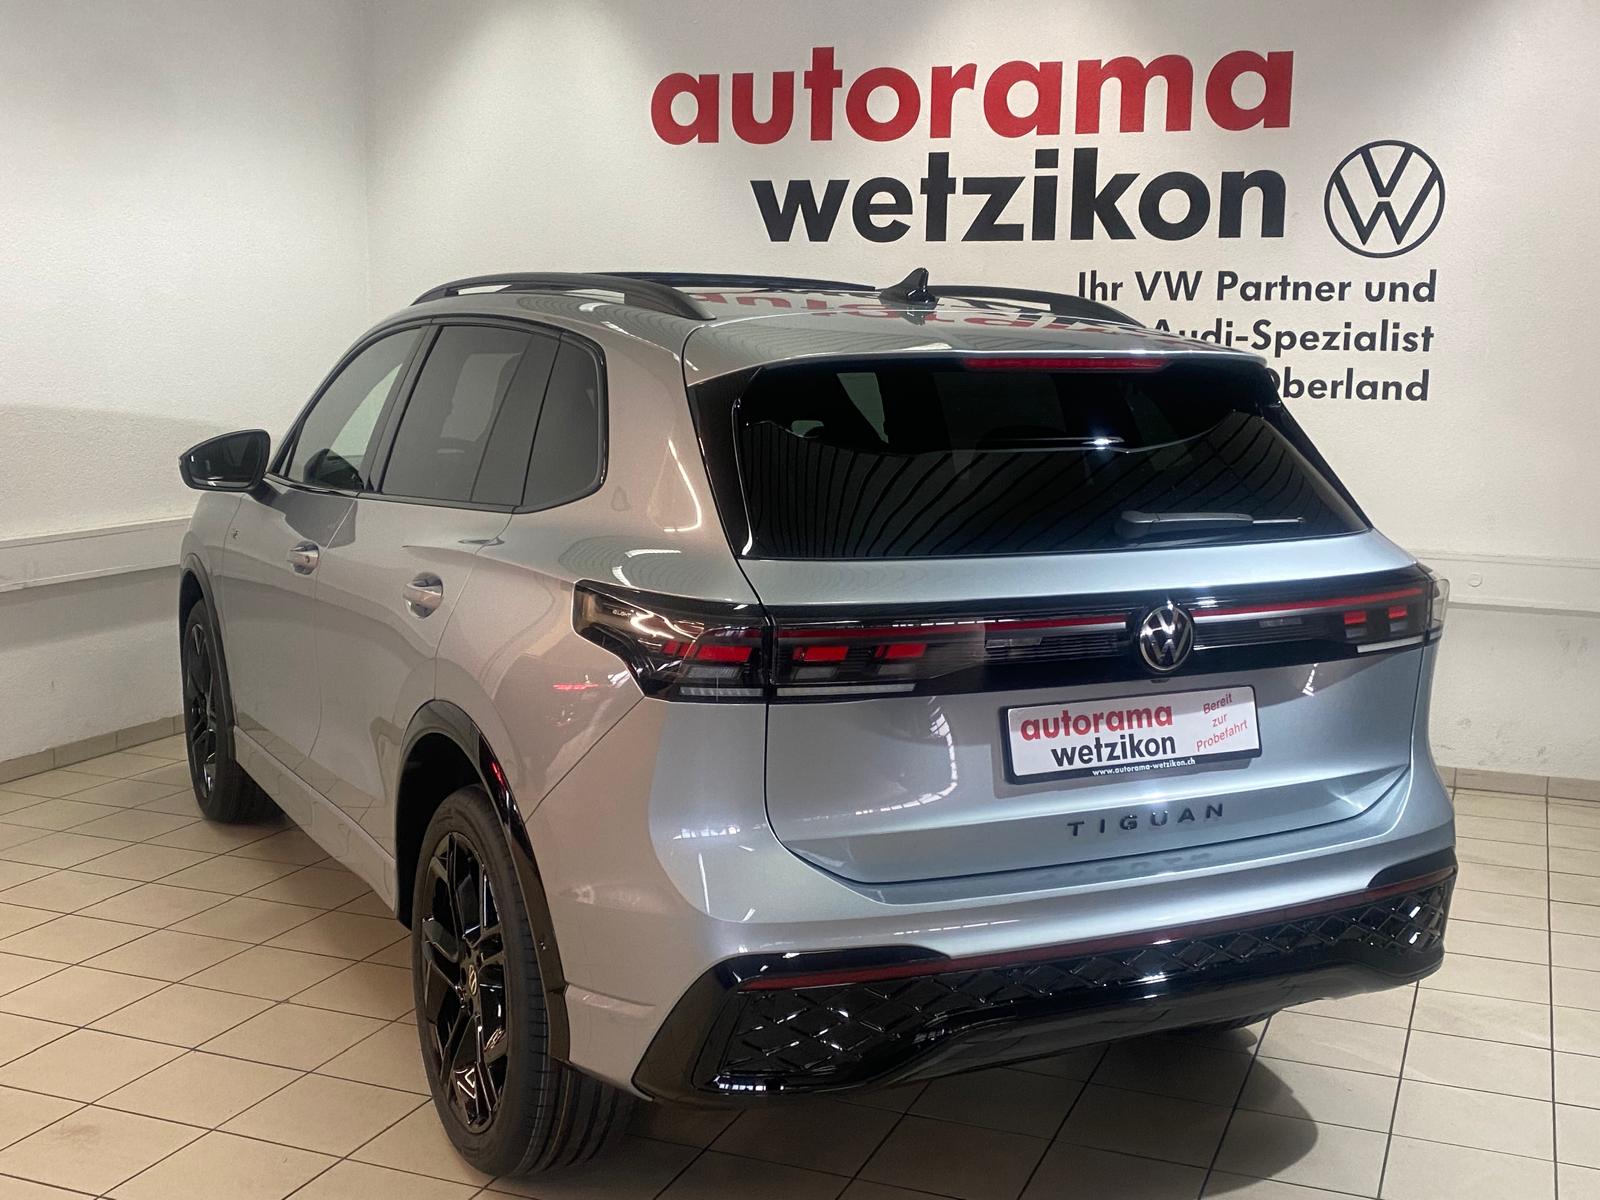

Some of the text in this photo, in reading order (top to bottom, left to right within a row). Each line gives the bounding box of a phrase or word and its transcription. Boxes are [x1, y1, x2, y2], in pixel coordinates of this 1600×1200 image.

[650, 46, 1294, 146] autorama
[751, 147, 1287, 243] wetzikon
[1078, 269, 1438, 302] Ihr VW Partner und
[1202, 693, 1233, 715] Bereit
[1211, 713, 1229, 728] zur
[1020, 705, 1173, 741] autorama
[1196, 719, 1249, 753] Probefahrt
[1051, 734, 1177, 767] wetzikon
[1092, 757, 1196, 776] www.autorama-wetzikon.ch
[1067, 803, 1224, 837] TIGUAN
